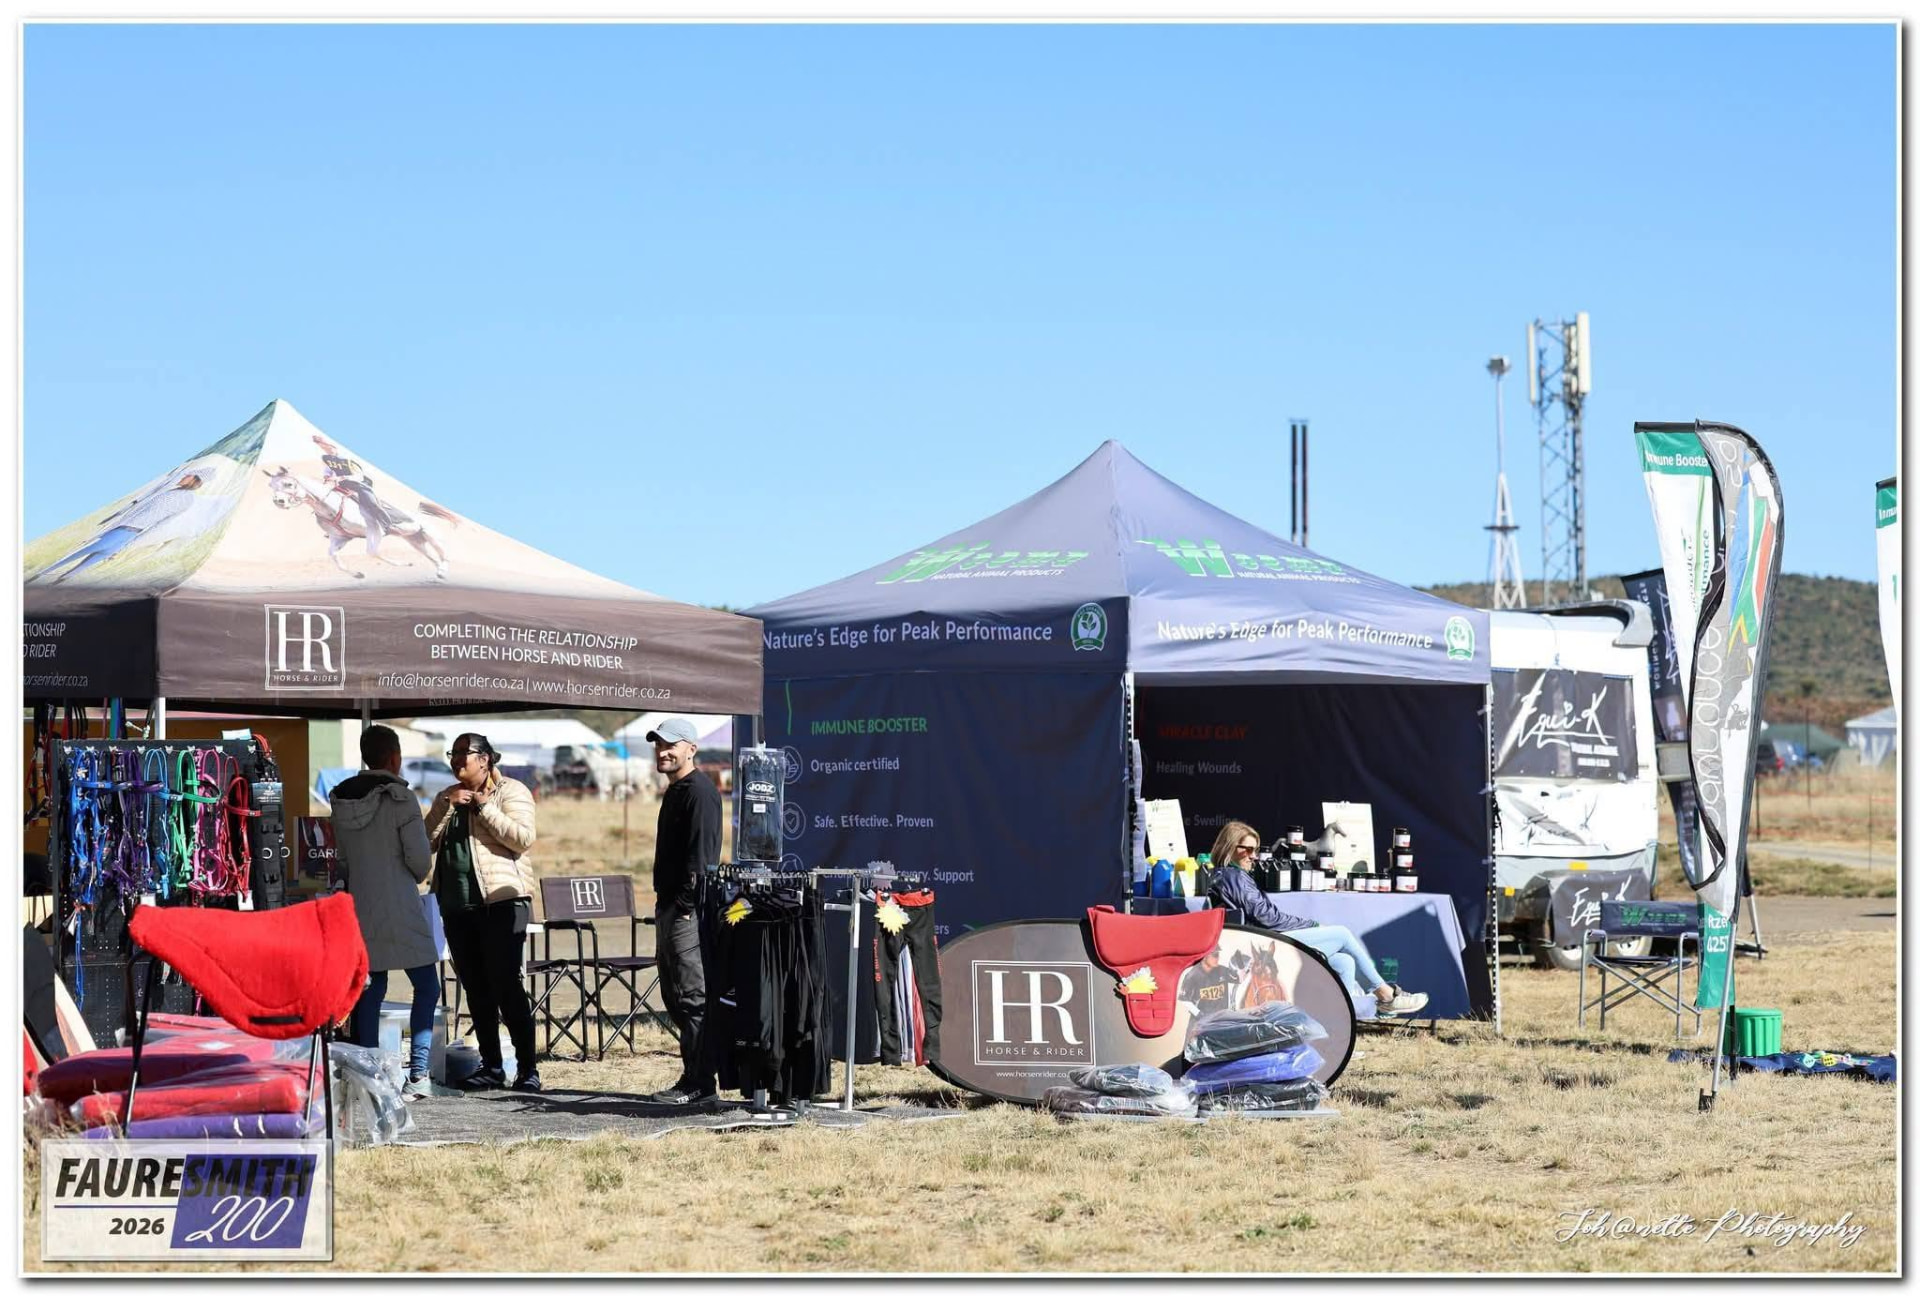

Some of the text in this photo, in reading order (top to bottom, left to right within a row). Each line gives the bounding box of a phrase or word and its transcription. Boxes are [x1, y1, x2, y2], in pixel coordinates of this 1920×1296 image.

[1012, 568, 1064, 577] PRODUCTS
[23, 622, 66, 637] TIONSHIP
[414, 623, 638, 652] COMPLETING THE RELATIONSHIP
[763, 621, 1052, 649] Nature's Edge for Peak Performance
[1158, 619, 1433, 649] Nature's Edge for Peak Performance
[273, 611, 338, 673] HR
[29, 644, 57, 658] RIDER
[431, 644, 624, 670] BETWEEN HORSE AND RIDER
[23, 672, 89, 687] orsenrider.co.za
[378, 672, 524, 690] info@horsenrider.co.za
[532, 678, 671, 700] www.horsenrider.co.za
[811, 717, 928, 736] IMMUNE BOOSTER
[811, 757, 900, 775] Organic certified
[1156, 760, 1242, 775] Healing Wounds
[814, 814, 934, 829] Safe. Effective. Proven
[933, 867, 975, 884] Support
[984, 970, 1083, 1044] HR
[985, 1045, 1085, 1056] HORSE & RIDER
[996, 1069, 1067, 1078] www.horsenrider.co
